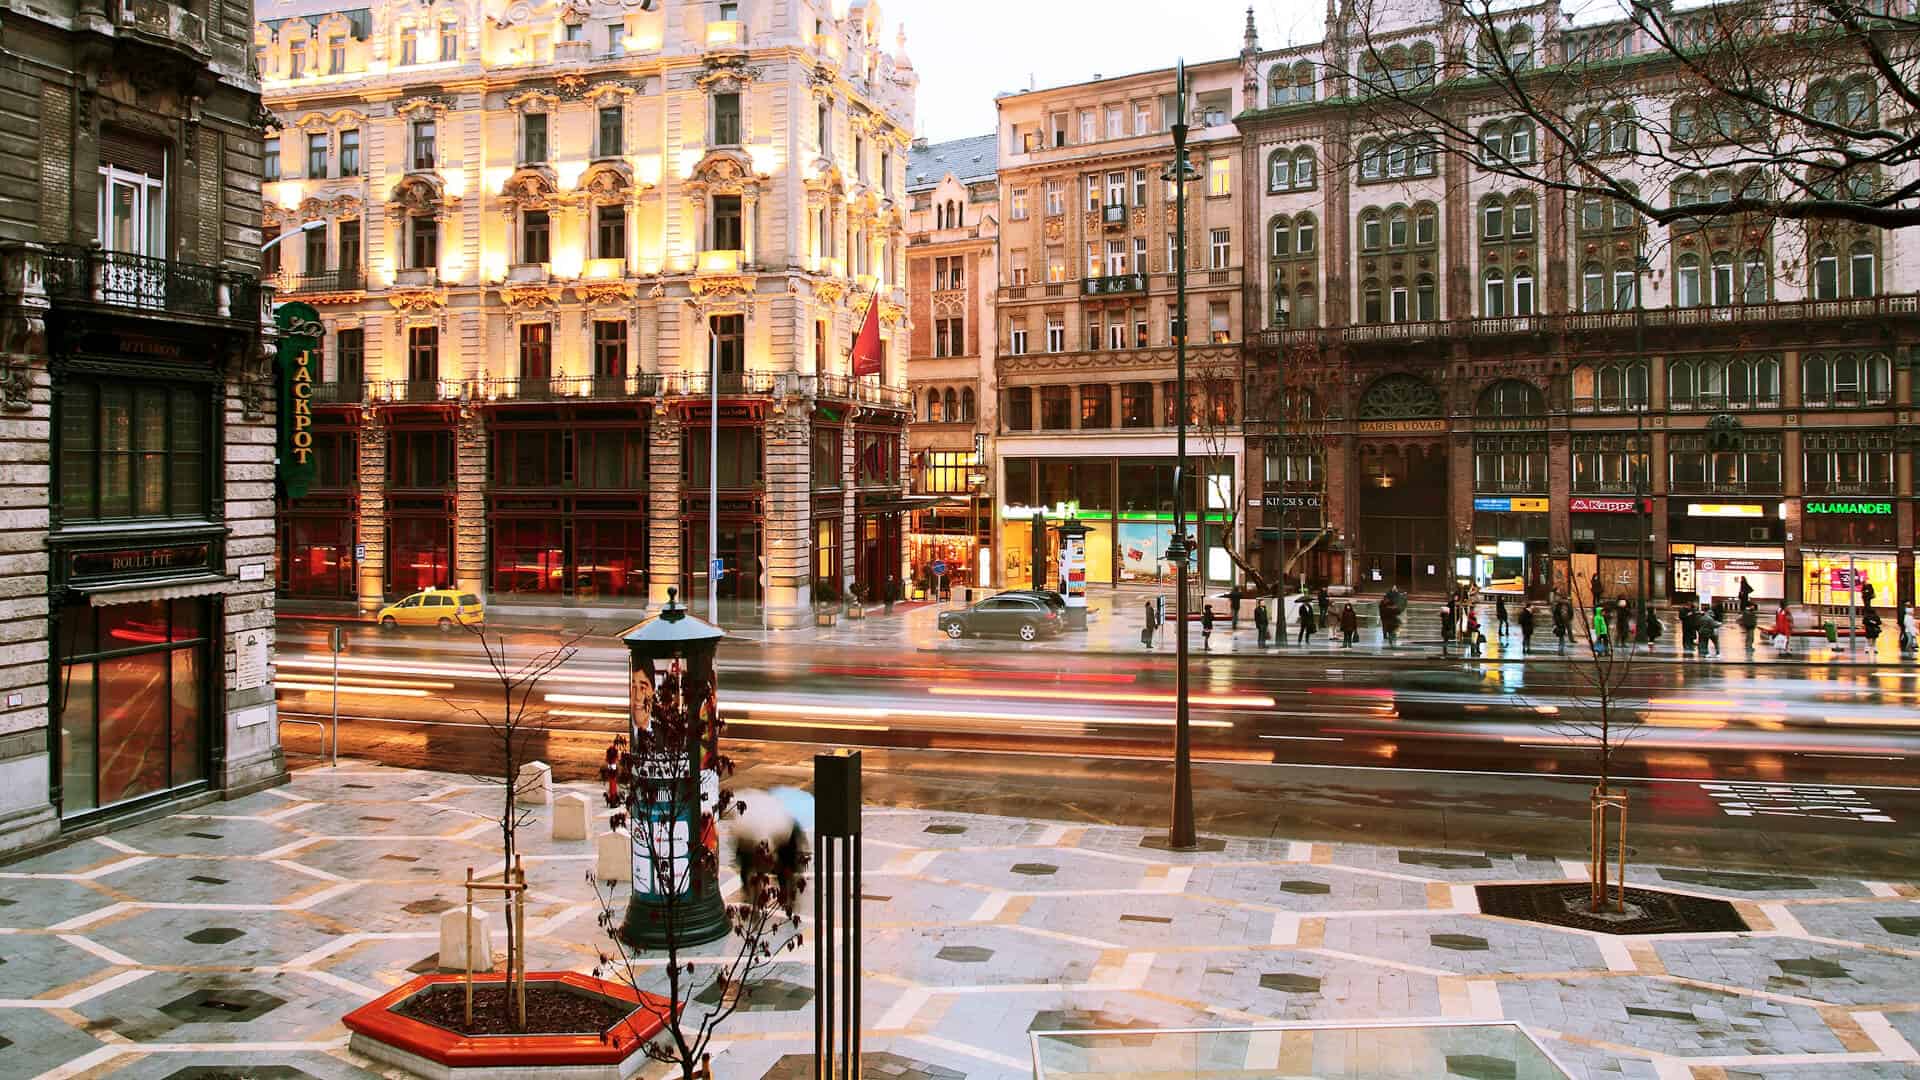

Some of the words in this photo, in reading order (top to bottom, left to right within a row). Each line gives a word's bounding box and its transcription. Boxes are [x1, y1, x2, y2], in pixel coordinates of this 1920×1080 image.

[293, 349, 314, 466] JACKPOT
[1806, 502, 1892, 514] SALAMANDER
[112, 553, 173, 570] ROULETTE
